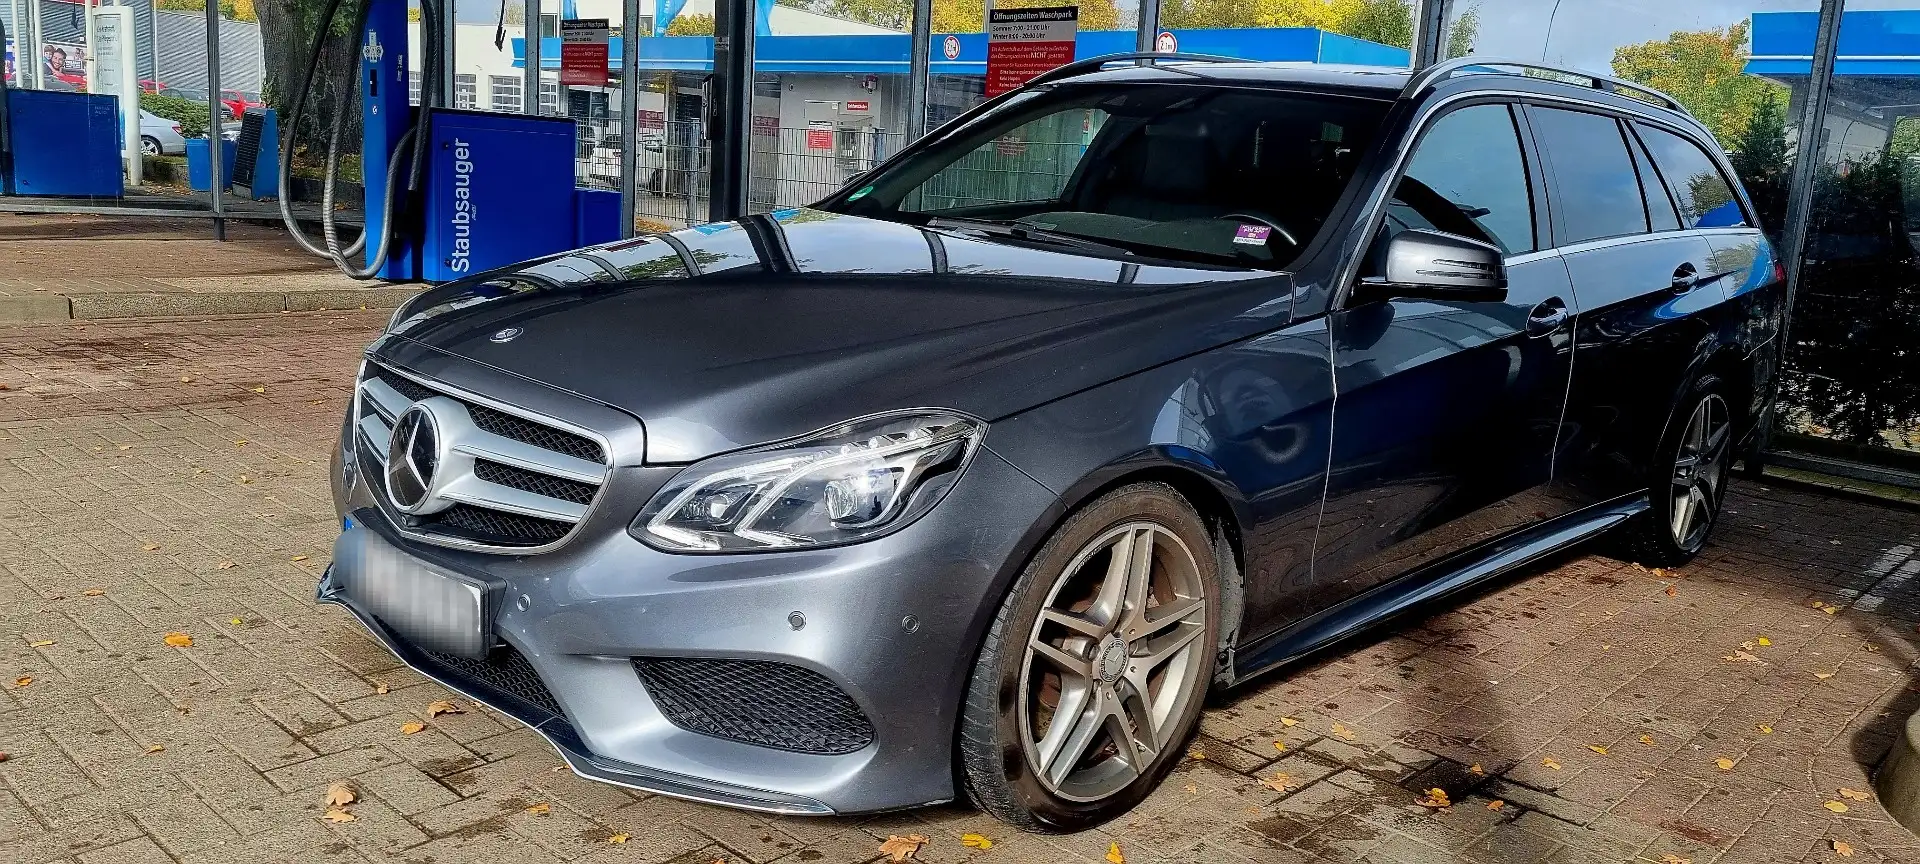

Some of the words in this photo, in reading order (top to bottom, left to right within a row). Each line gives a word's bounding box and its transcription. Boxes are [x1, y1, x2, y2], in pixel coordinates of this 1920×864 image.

[994, 12, 1038, 21] Öffnungszeiten
[1039, 10, 1072, 20] Waschpark
[452, 138, 473, 272] Staubsauger
